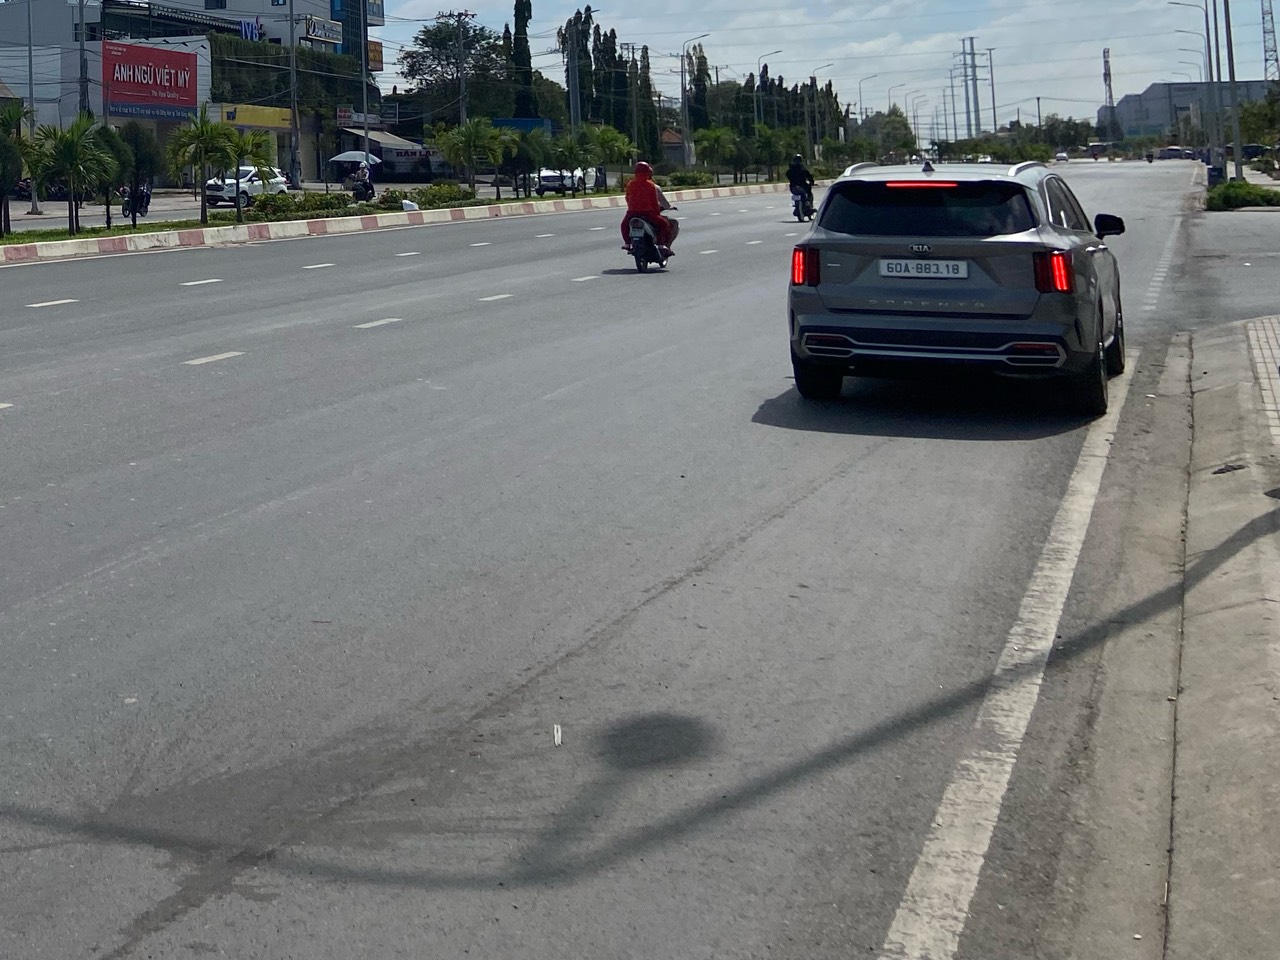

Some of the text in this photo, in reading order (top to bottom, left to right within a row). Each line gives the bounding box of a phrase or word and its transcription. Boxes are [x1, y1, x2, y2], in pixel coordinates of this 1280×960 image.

[113, 62, 190, 89] ANH NGỮ VIỆT MỸ
[911, 244, 930, 252] KIA
